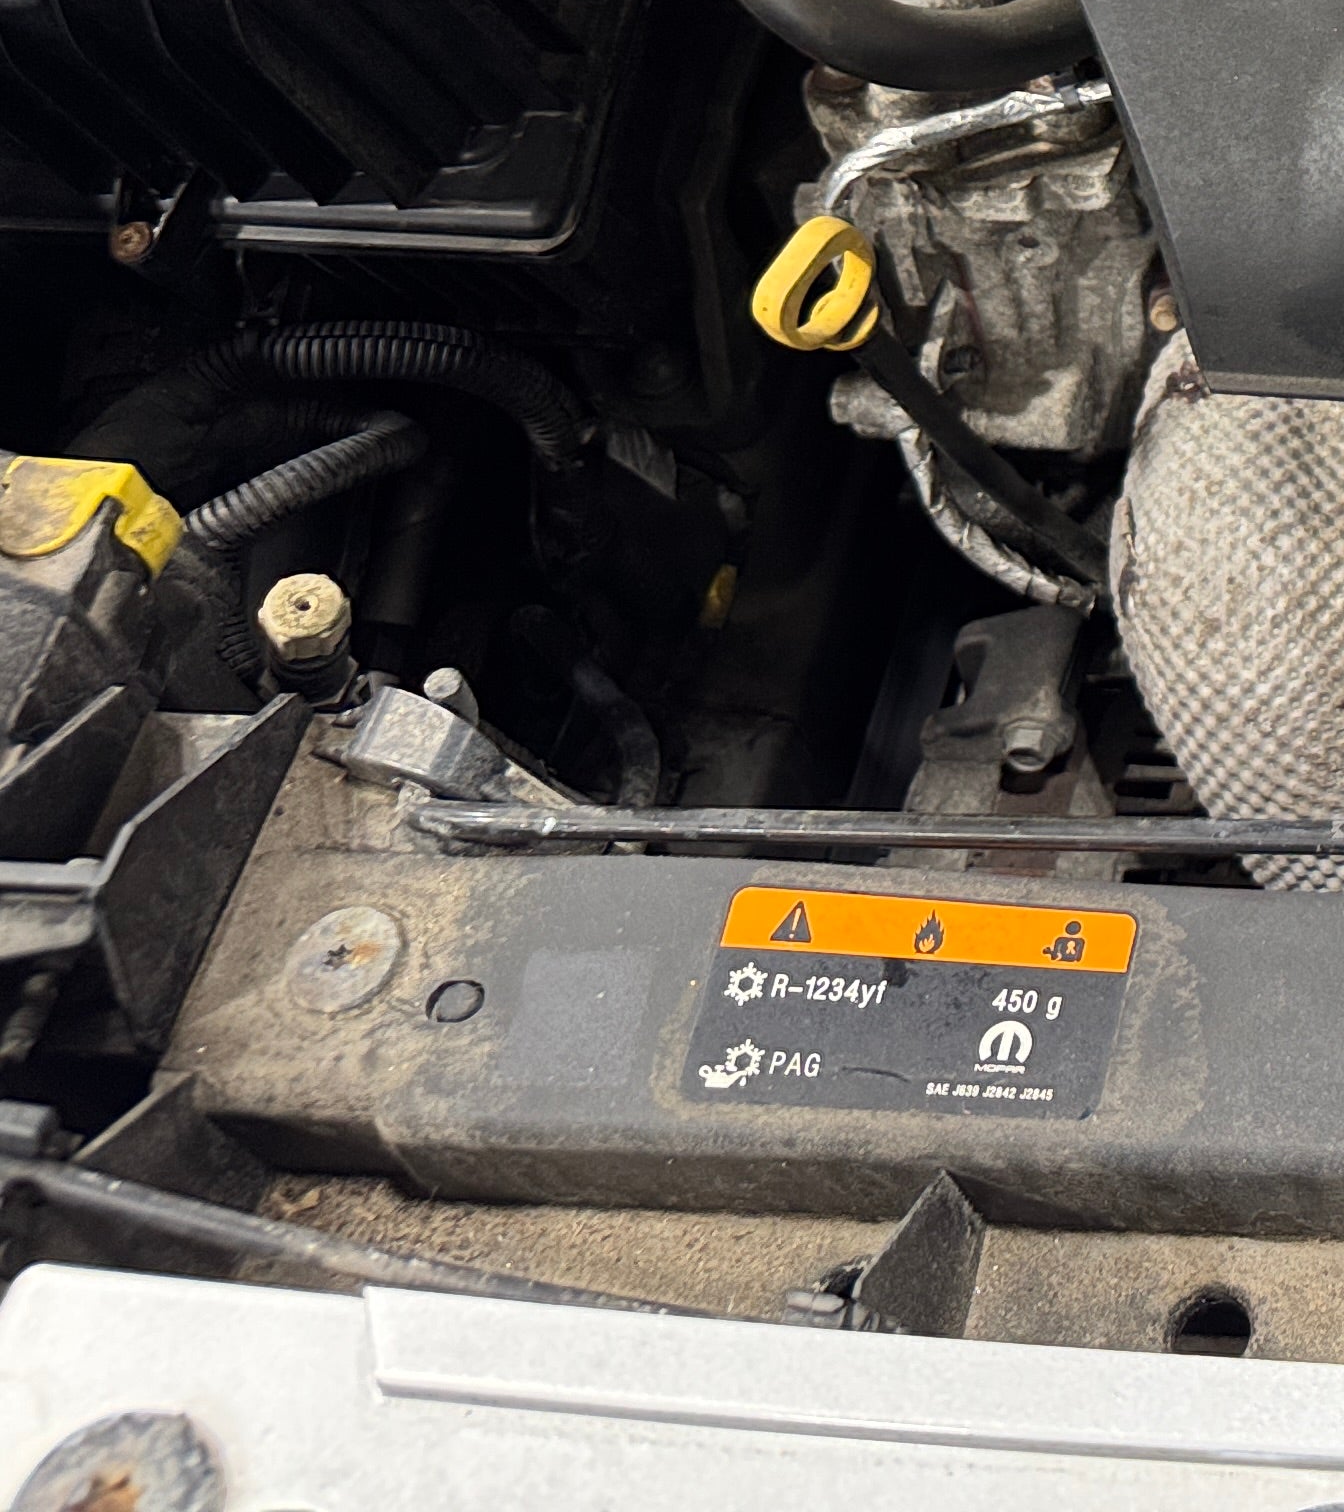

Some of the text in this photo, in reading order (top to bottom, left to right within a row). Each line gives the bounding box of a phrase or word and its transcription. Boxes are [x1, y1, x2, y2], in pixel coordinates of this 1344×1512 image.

[770, 973, 888, 1009] R-1234yf
[991, 988, 1063, 1021] 450 g
[768, 1051, 823, 1078] PAG
[973, 1063, 1026, 1075] MOPAR
[925, 1082, 950, 1096] SAE
